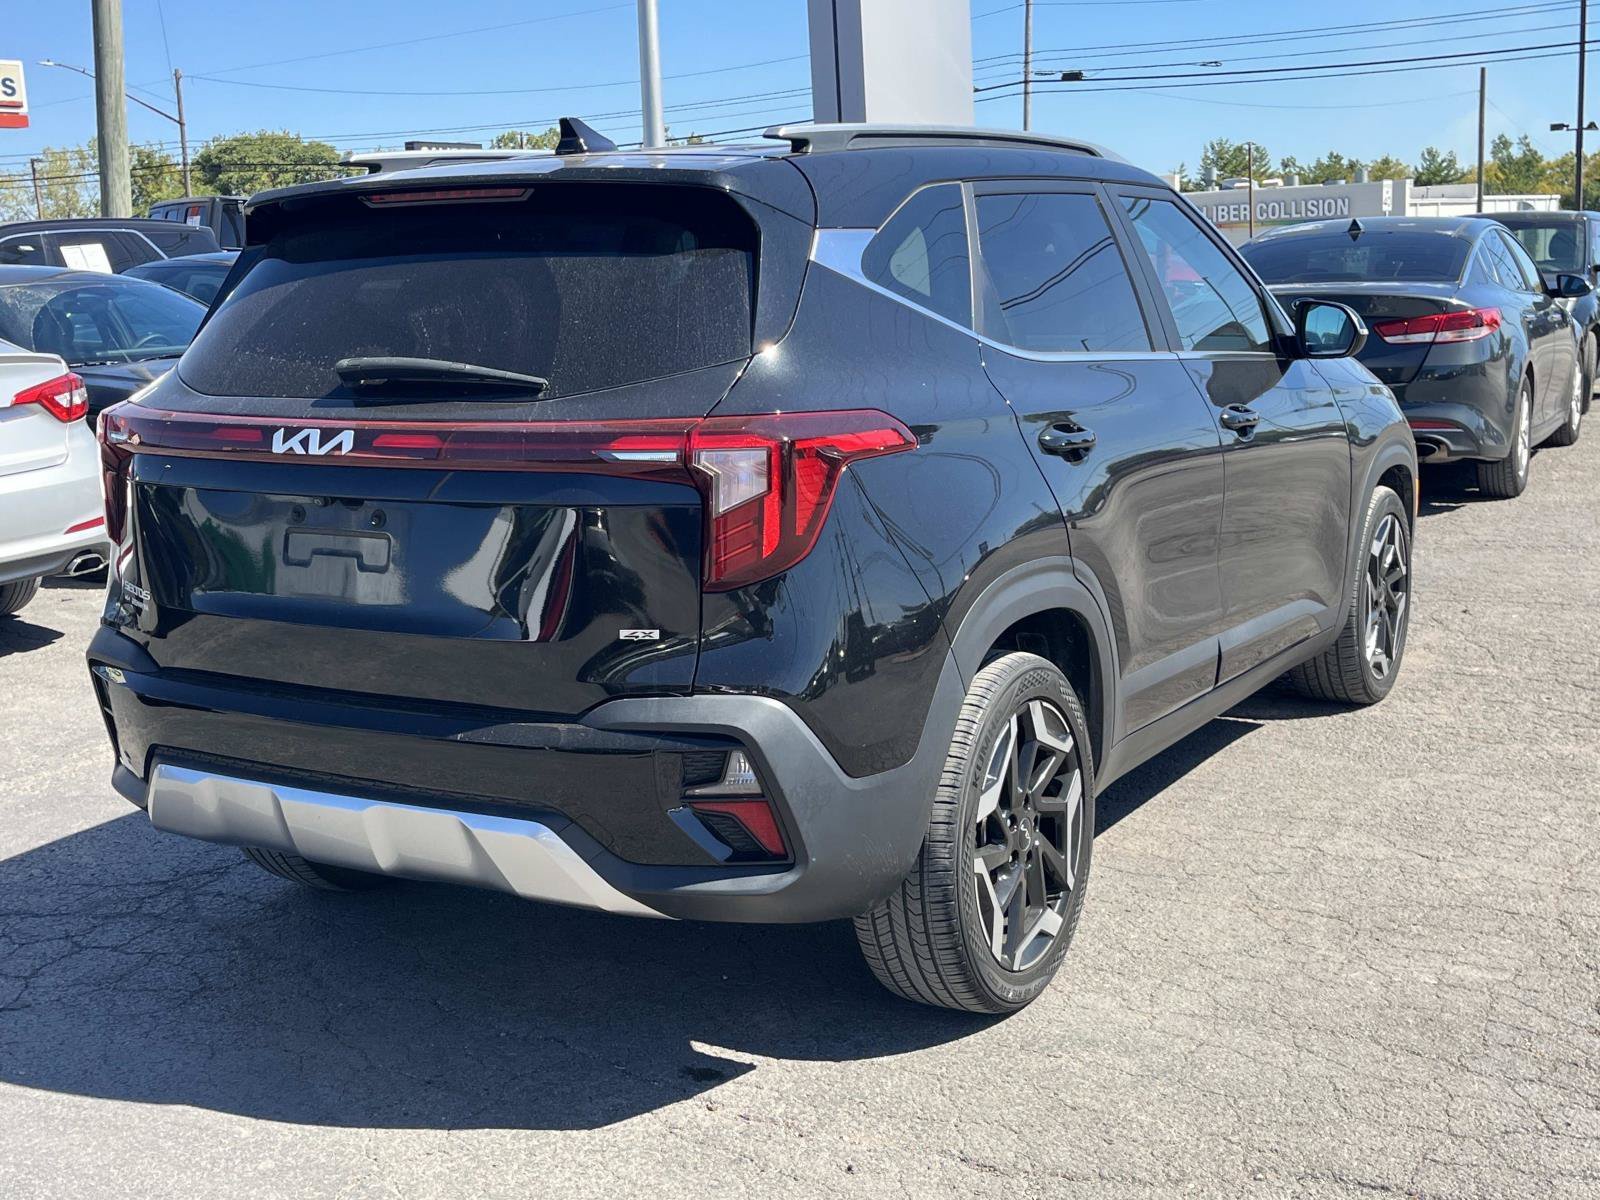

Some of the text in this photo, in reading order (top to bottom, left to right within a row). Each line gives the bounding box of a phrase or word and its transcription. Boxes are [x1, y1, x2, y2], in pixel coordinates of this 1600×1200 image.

[1, 77, 17, 97] S
[1256, 197, 1349, 220] COLLISION
[272, 428, 355, 456] KIA
